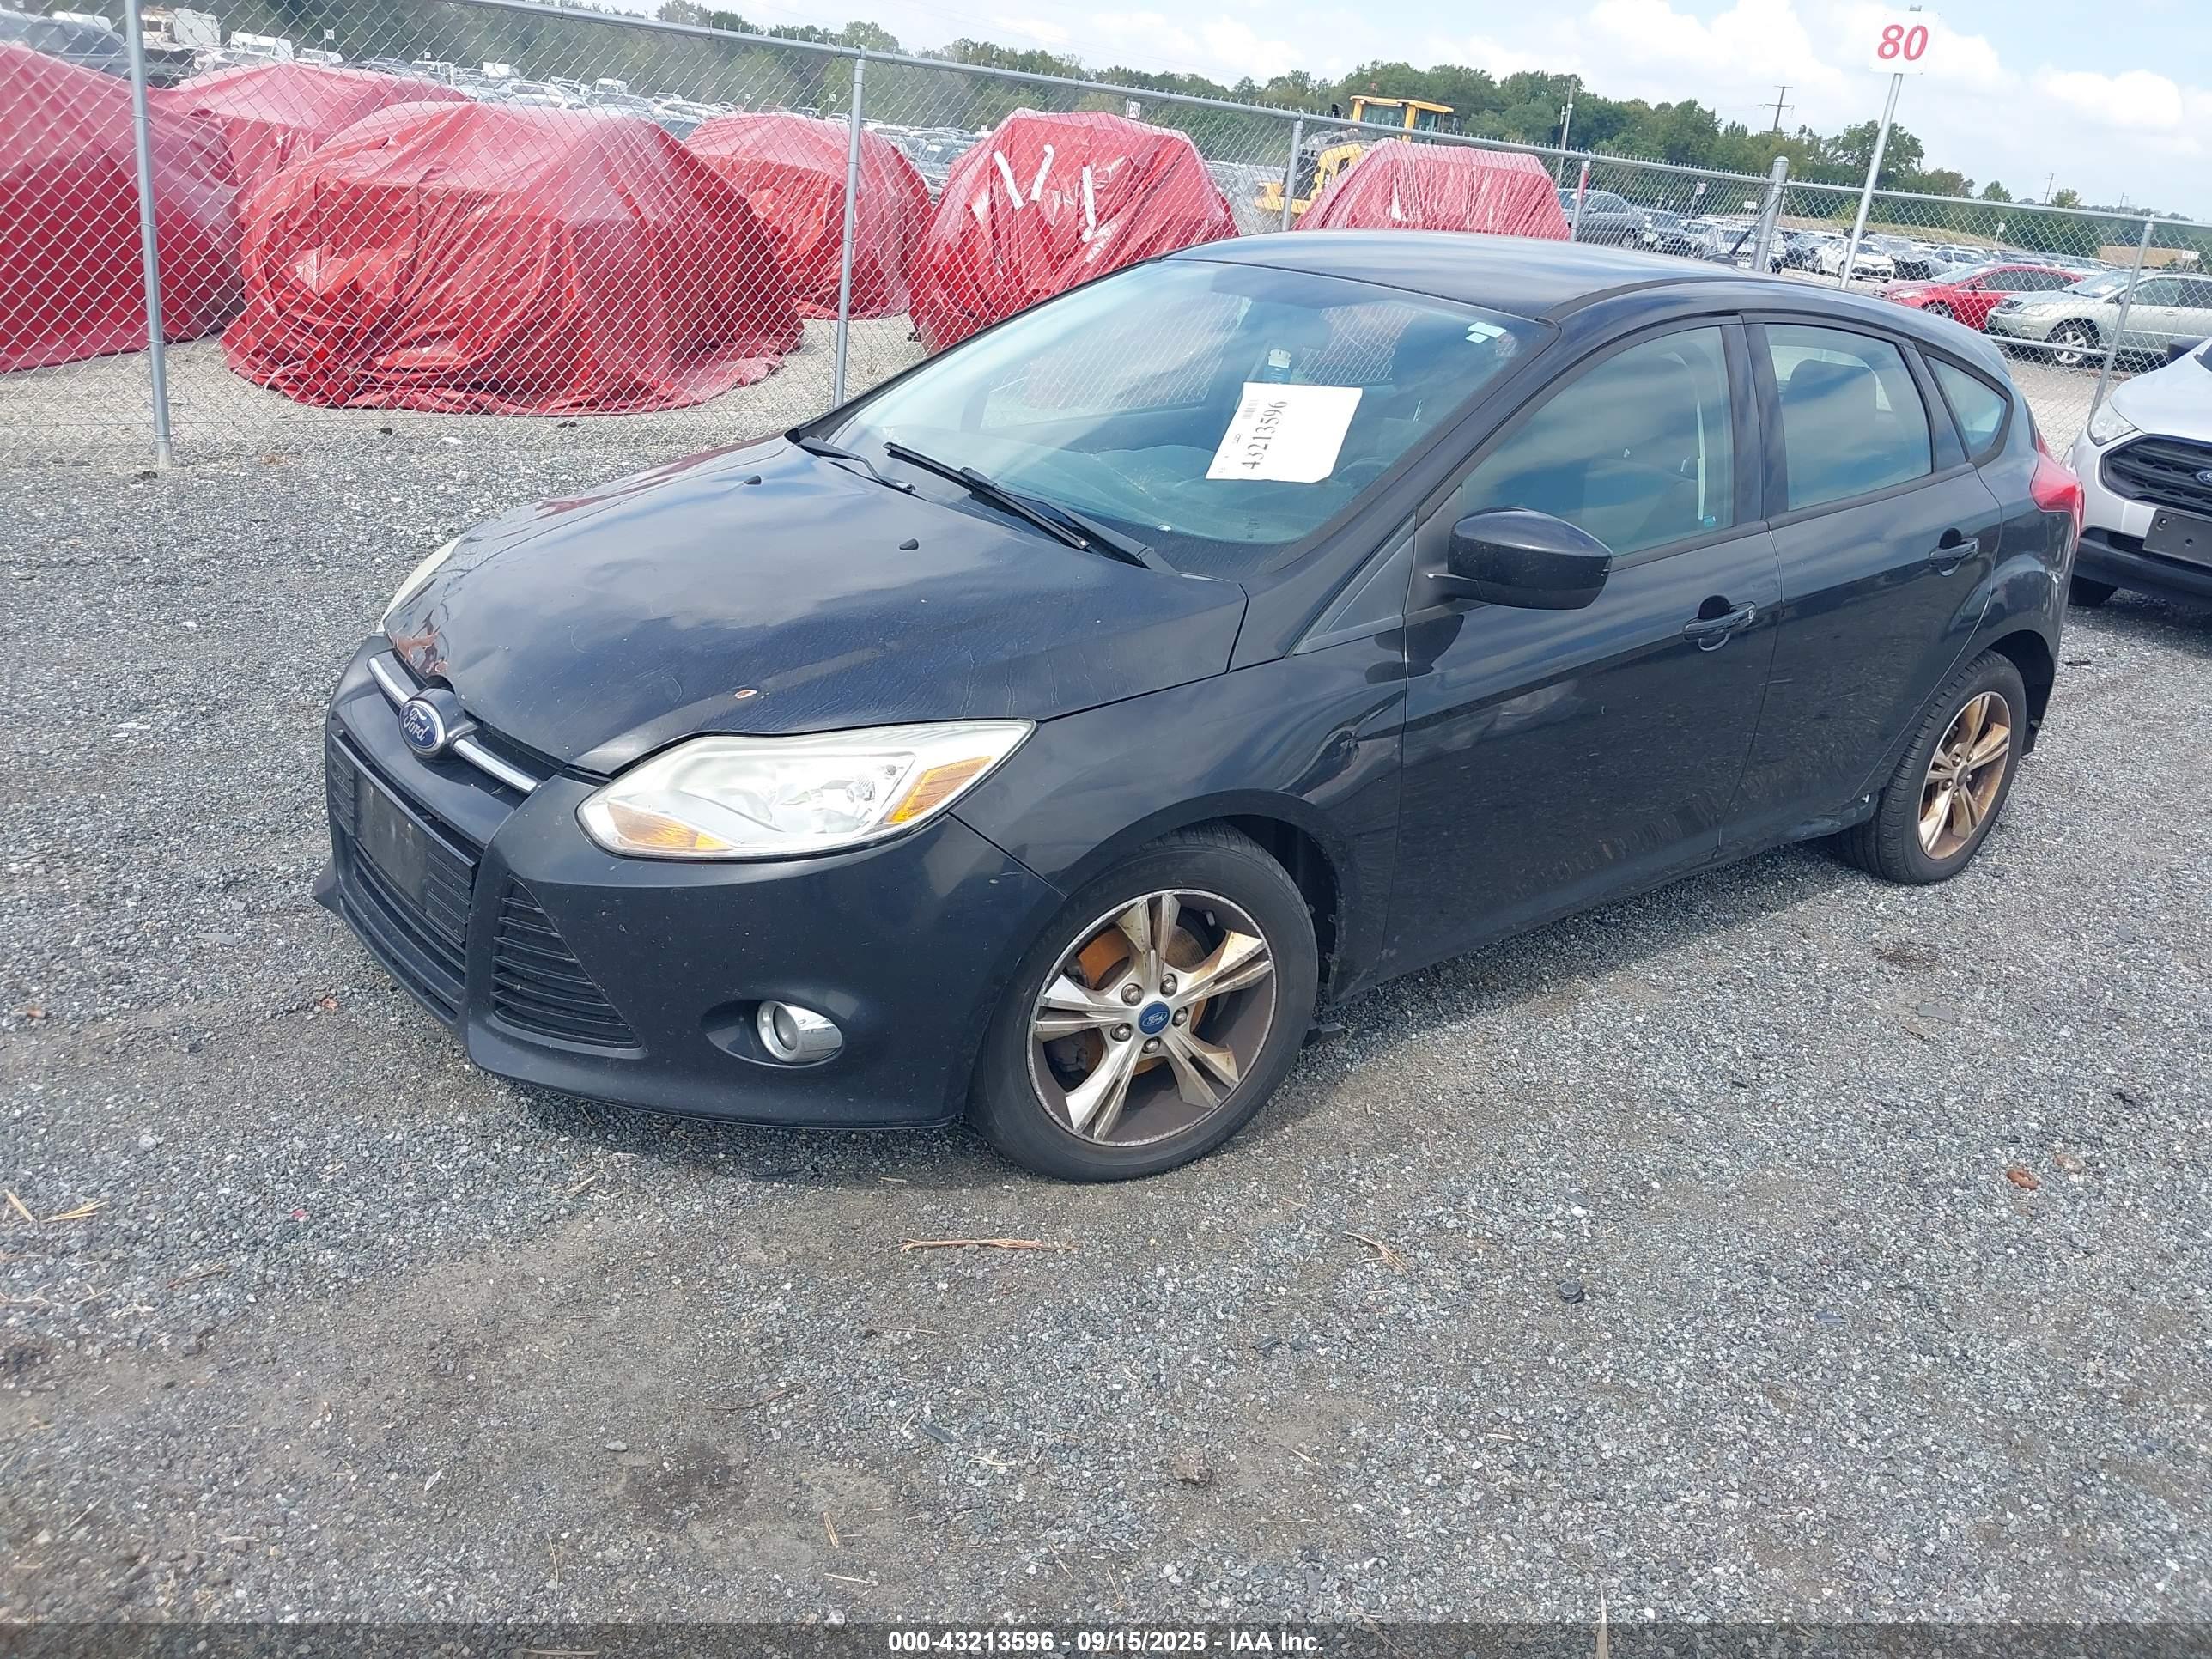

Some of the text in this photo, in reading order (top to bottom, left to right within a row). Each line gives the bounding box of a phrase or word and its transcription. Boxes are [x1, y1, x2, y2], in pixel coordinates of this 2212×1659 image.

[1877, 24, 1929, 61] 80
[1241, 400, 1288, 470] 43213596
[404, 707, 430, 742] Ford
